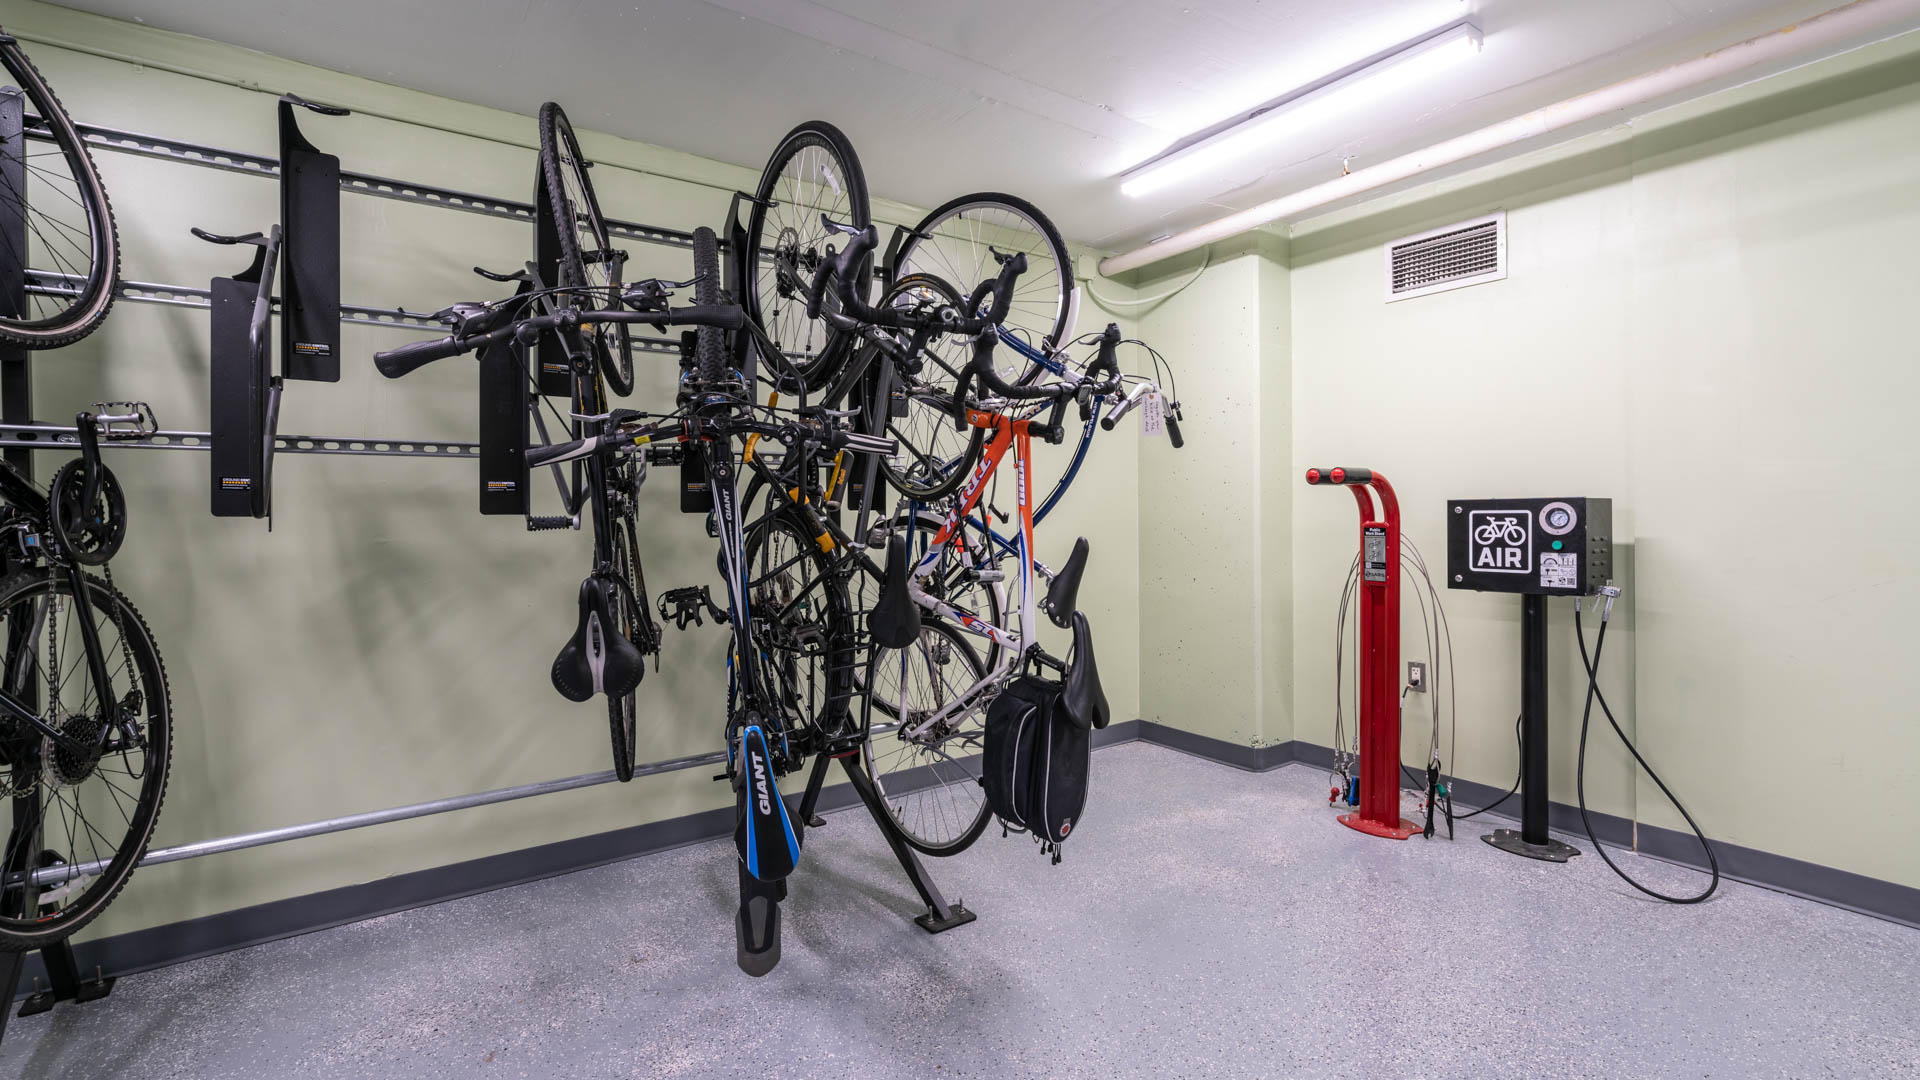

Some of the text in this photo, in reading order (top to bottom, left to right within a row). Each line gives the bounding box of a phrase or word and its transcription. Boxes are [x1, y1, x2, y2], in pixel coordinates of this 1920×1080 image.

[722, 489, 733, 521] GIANT
[944, 457, 992, 534] TREK
[1478, 547, 1522, 568] AIR
[751, 751, 771, 816] GIANT
